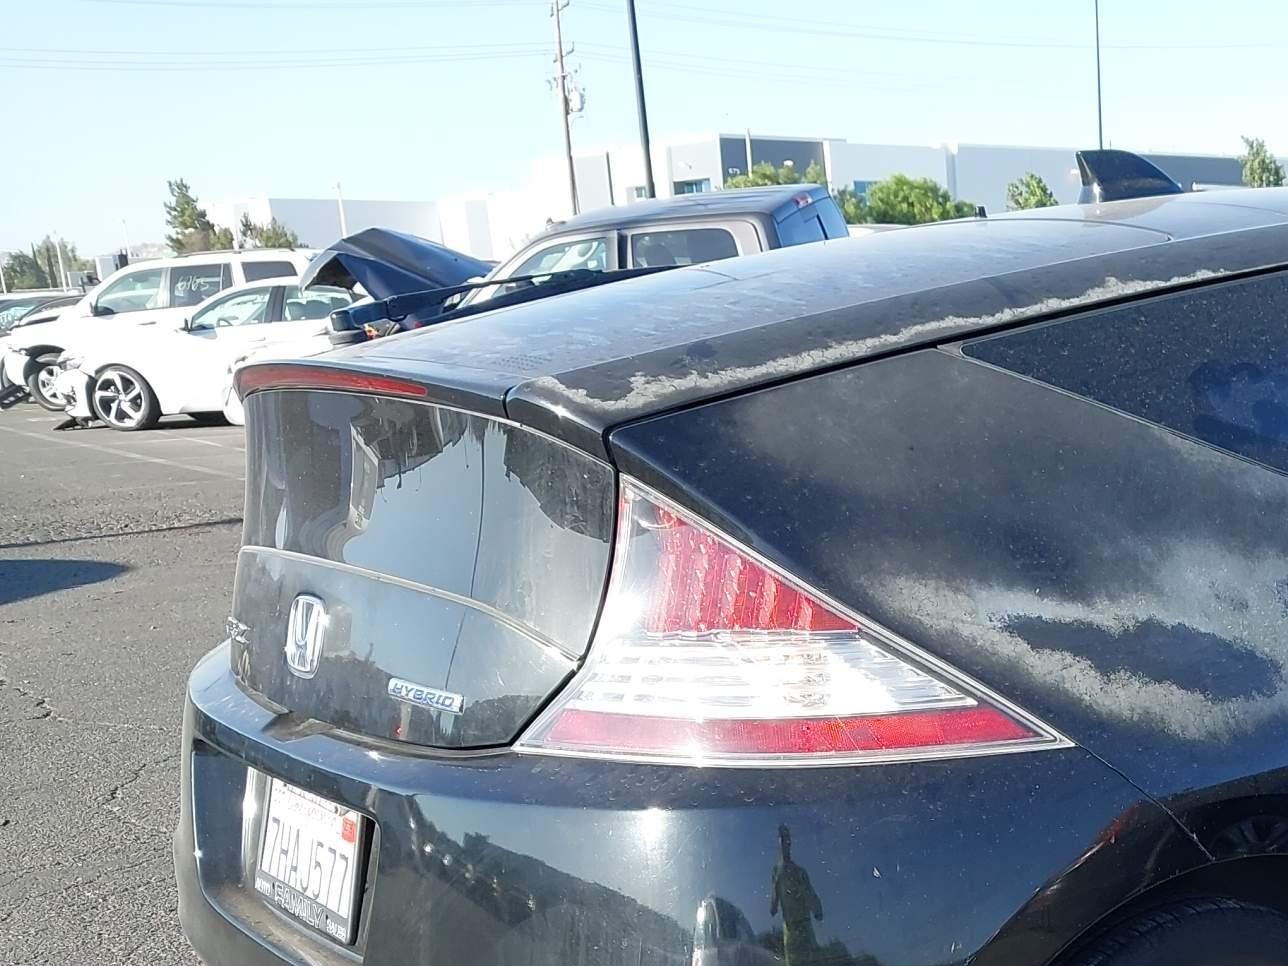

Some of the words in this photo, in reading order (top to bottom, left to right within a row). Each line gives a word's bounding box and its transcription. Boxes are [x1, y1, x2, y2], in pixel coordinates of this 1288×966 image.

[390, 682, 455, 708] HYBRID
[267, 816, 349, 913] 7HAJ577
[274, 881, 324, 929] FAMILY
